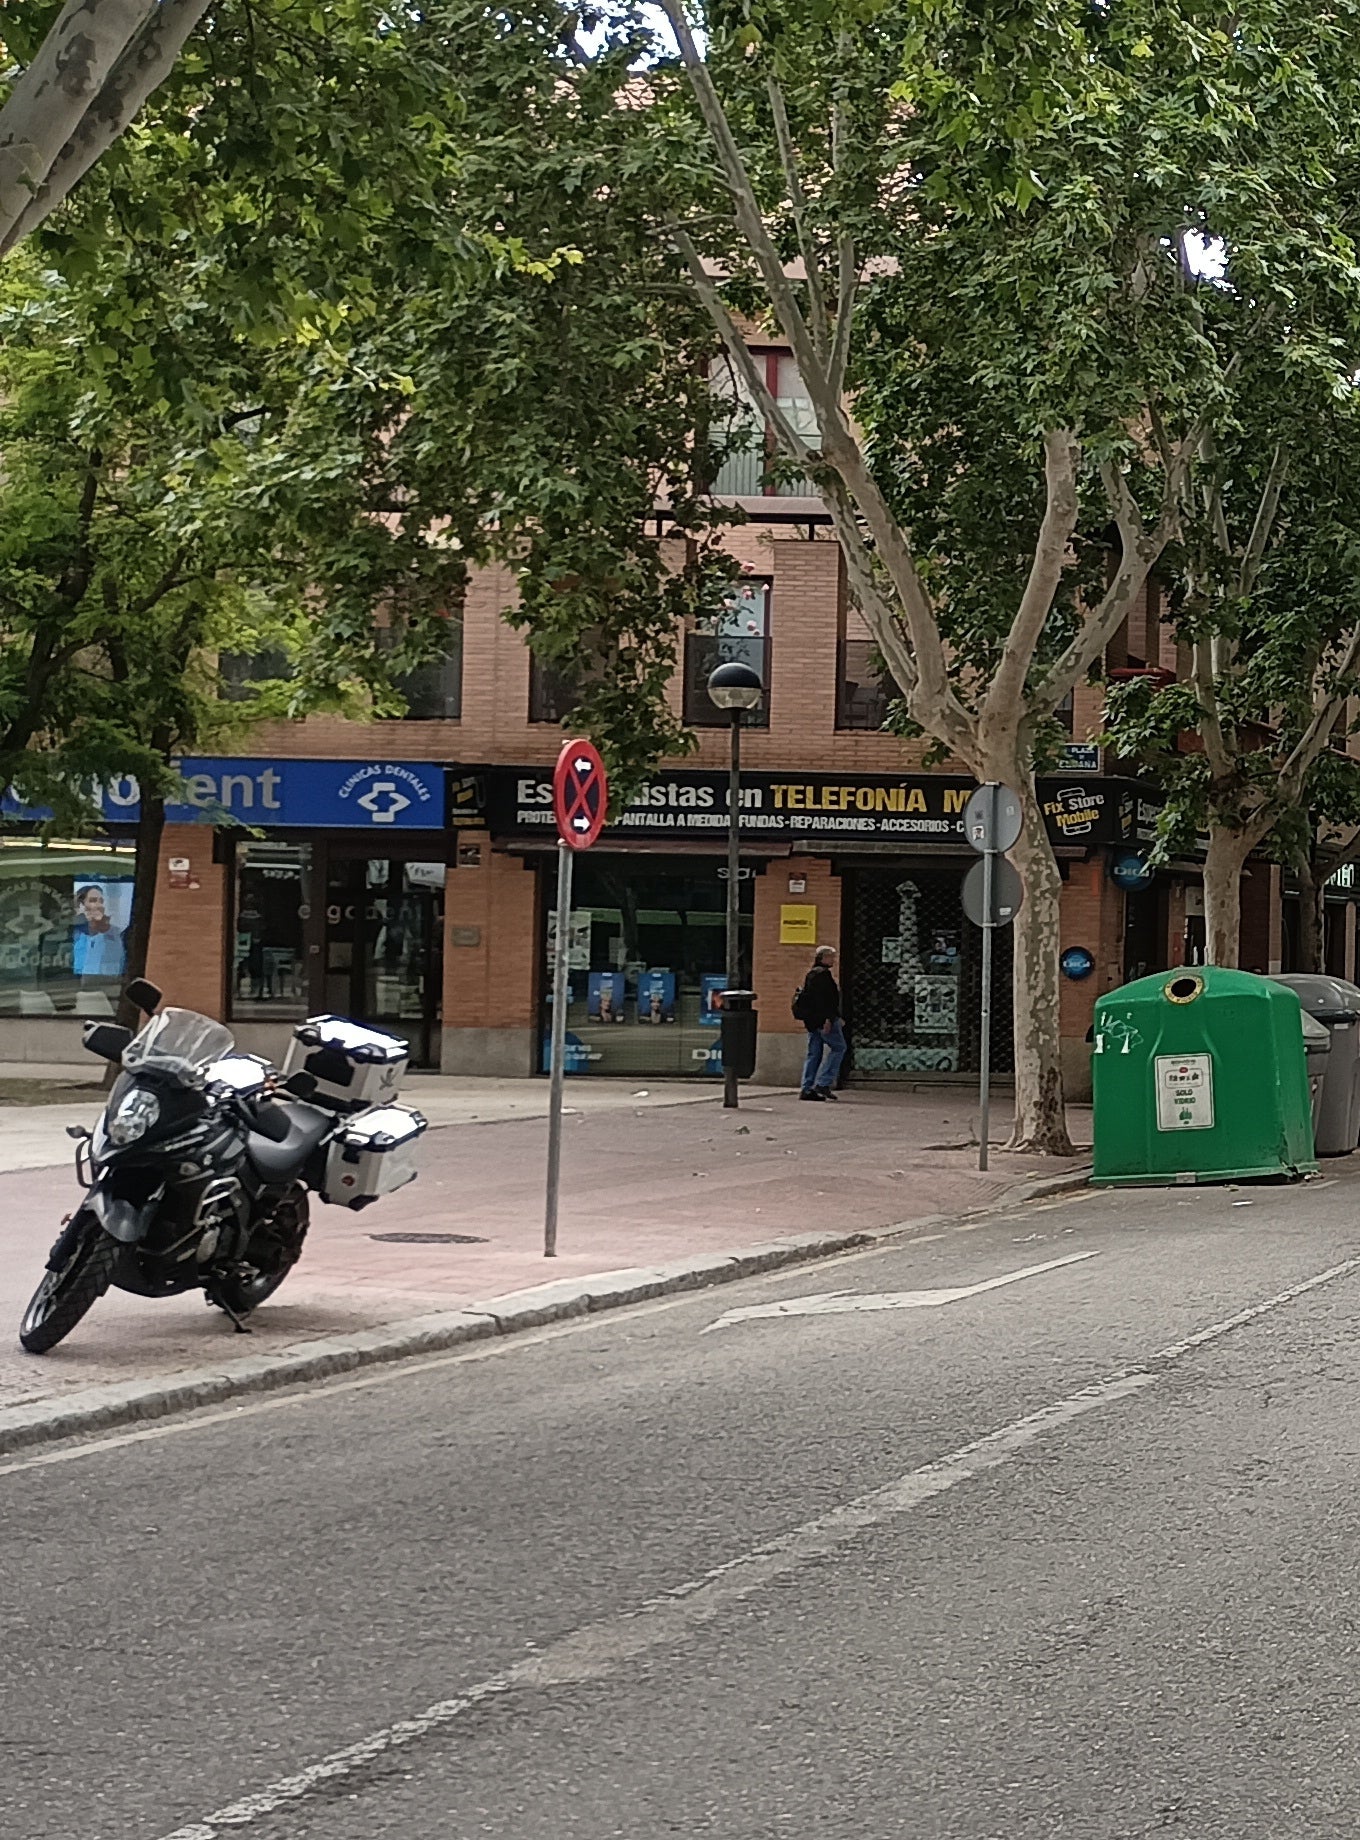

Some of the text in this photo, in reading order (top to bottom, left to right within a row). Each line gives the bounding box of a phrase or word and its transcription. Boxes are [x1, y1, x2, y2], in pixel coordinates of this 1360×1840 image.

[385, 764, 431, 801] DENTALES
[769, 782, 928, 813] TELEFONÍA
[1043, 793, 1105, 815] Fix Store
[687, 813, 731, 827] MEDIDA
[1056, 808, 1100, 827] Mobile
